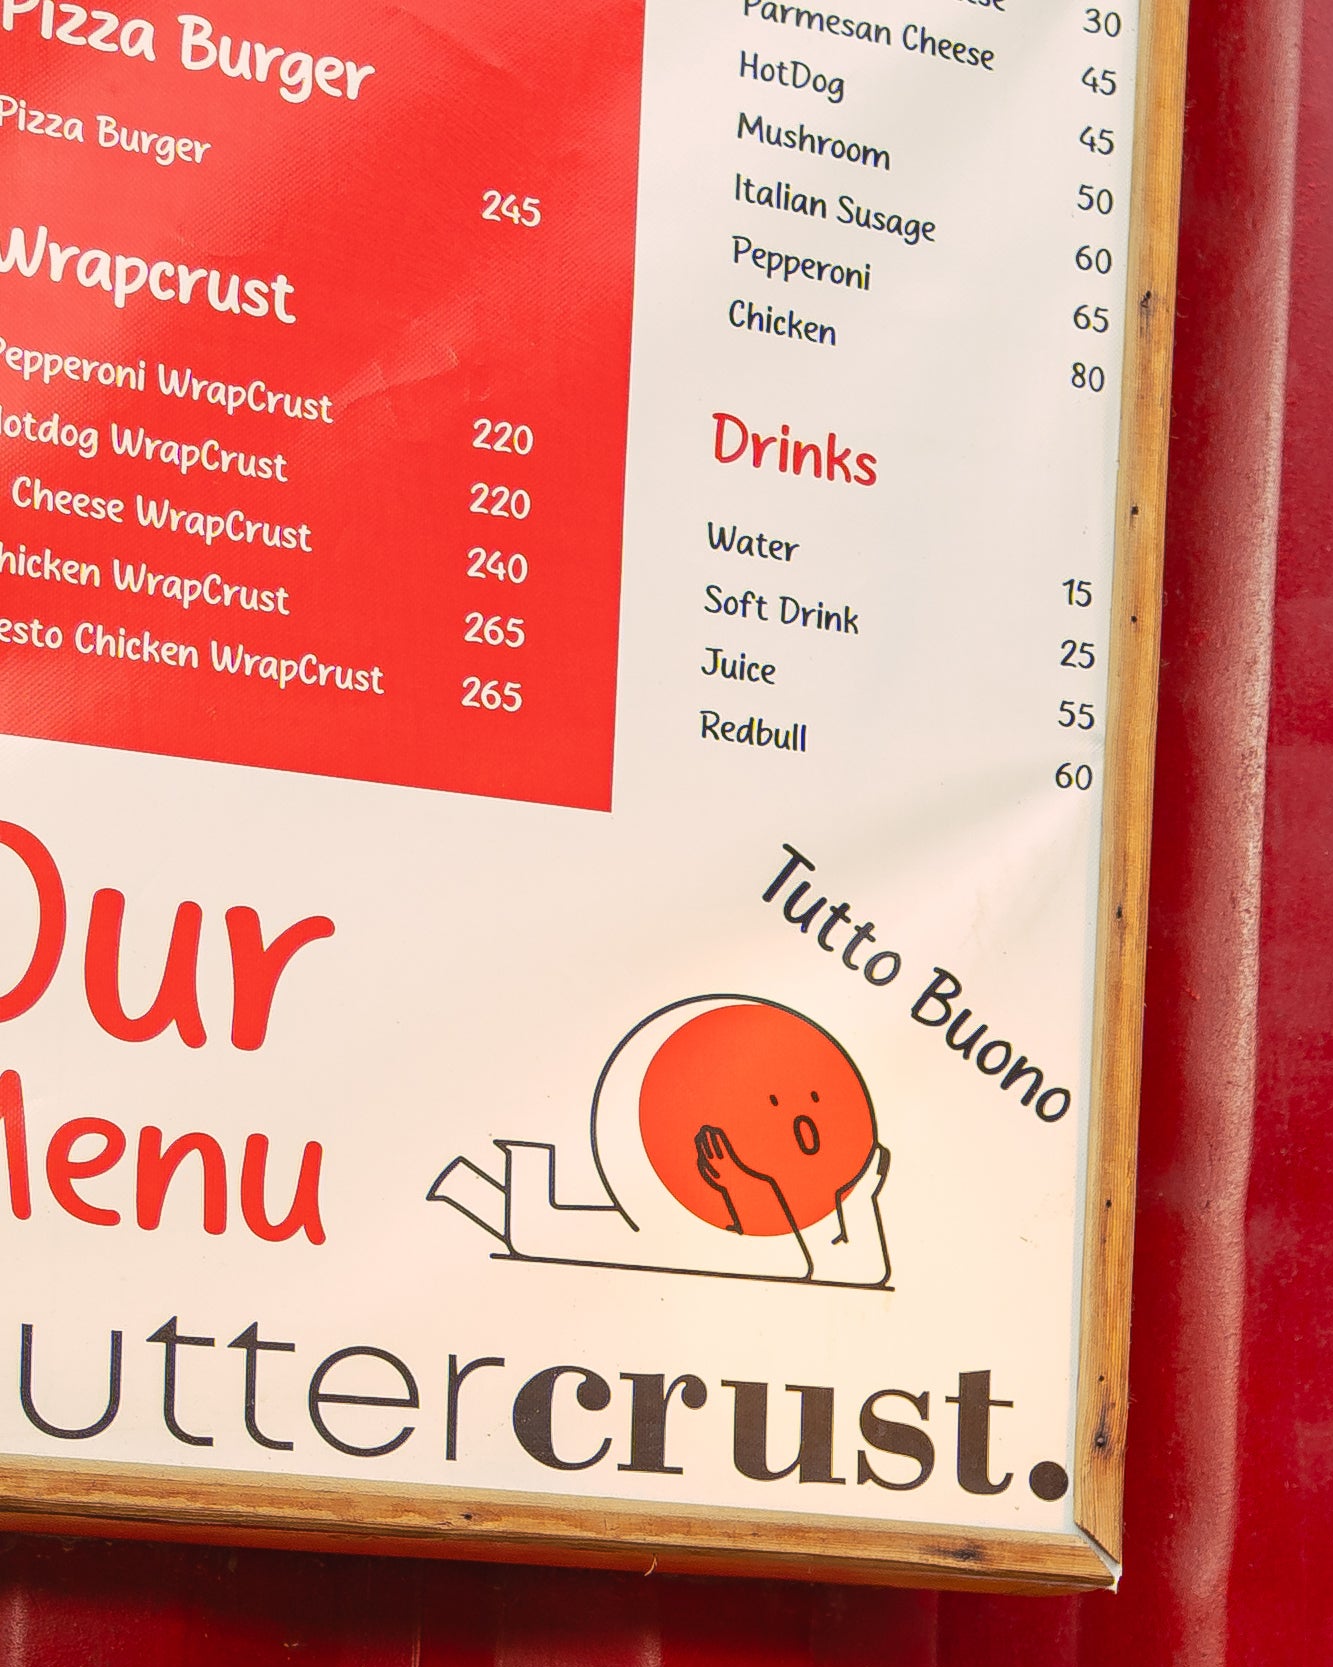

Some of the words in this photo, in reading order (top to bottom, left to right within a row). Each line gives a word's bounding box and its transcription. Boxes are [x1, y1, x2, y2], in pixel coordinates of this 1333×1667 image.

[1084, 9, 1120, 37] 30
[177, 15, 375, 103] Burger
[903, 25, 994, 70] Cheese
[741, 51, 844, 103] HotDog
[1082, 67, 1116, 95] 45
[0, 95, 83, 142] Pizza
[96, 115, 211, 165] Burger
[738, 113, 889, 170] Mushroom
[1080, 126, 1113, 155] 45
[482, 190, 540, 226] 245
[736, 173, 826, 218] Italian
[837, 196, 935, 245] Susage
[1078, 184, 1113, 214] 50
[0, 226, 296, 323] Wrapcrust
[732, 236, 870, 290] Pepperoni
[1076, 245, 1111, 274] 60
[729, 300, 835, 345] Chicken
[1074, 305, 1108, 333] 65
[159, 364, 333, 423] WrapCrust
[1072, 362, 1104, 392] 80
[0, 405, 98, 458] otdog
[112, 423, 287, 482] WrapCrust
[473, 419, 533, 454] 220
[714, 413, 876, 485] Drinks
[12, 476, 124, 522] Cheese
[137, 495, 312, 552] WrapCrust
[470, 483, 530, 519] 220
[708, 522, 799, 561] Water
[467, 548, 527, 583] 240
[114, 559, 289, 615] WrapCrust
[1063, 579, 1091, 607] 15
[465, 612, 524, 647] 265
[704, 585, 768, 620] Soft
[780, 596, 858, 634] Drink
[75, 623, 198, 668] Chicken
[211, 641, 384, 694] WrapCrust
[701, 648, 775, 684] Juice
[1061, 640, 1094, 668] 25
[462, 677, 522, 711] 265
[700, 711, 806, 752] Redbull
[1058, 701, 1094, 729] 55
[1056, 763, 1092, 790] 60
[762, 844, 901, 986] Tutto
[911, 967, 1070, 1122] Buono
[0, 1070, 325, 1245] enu
